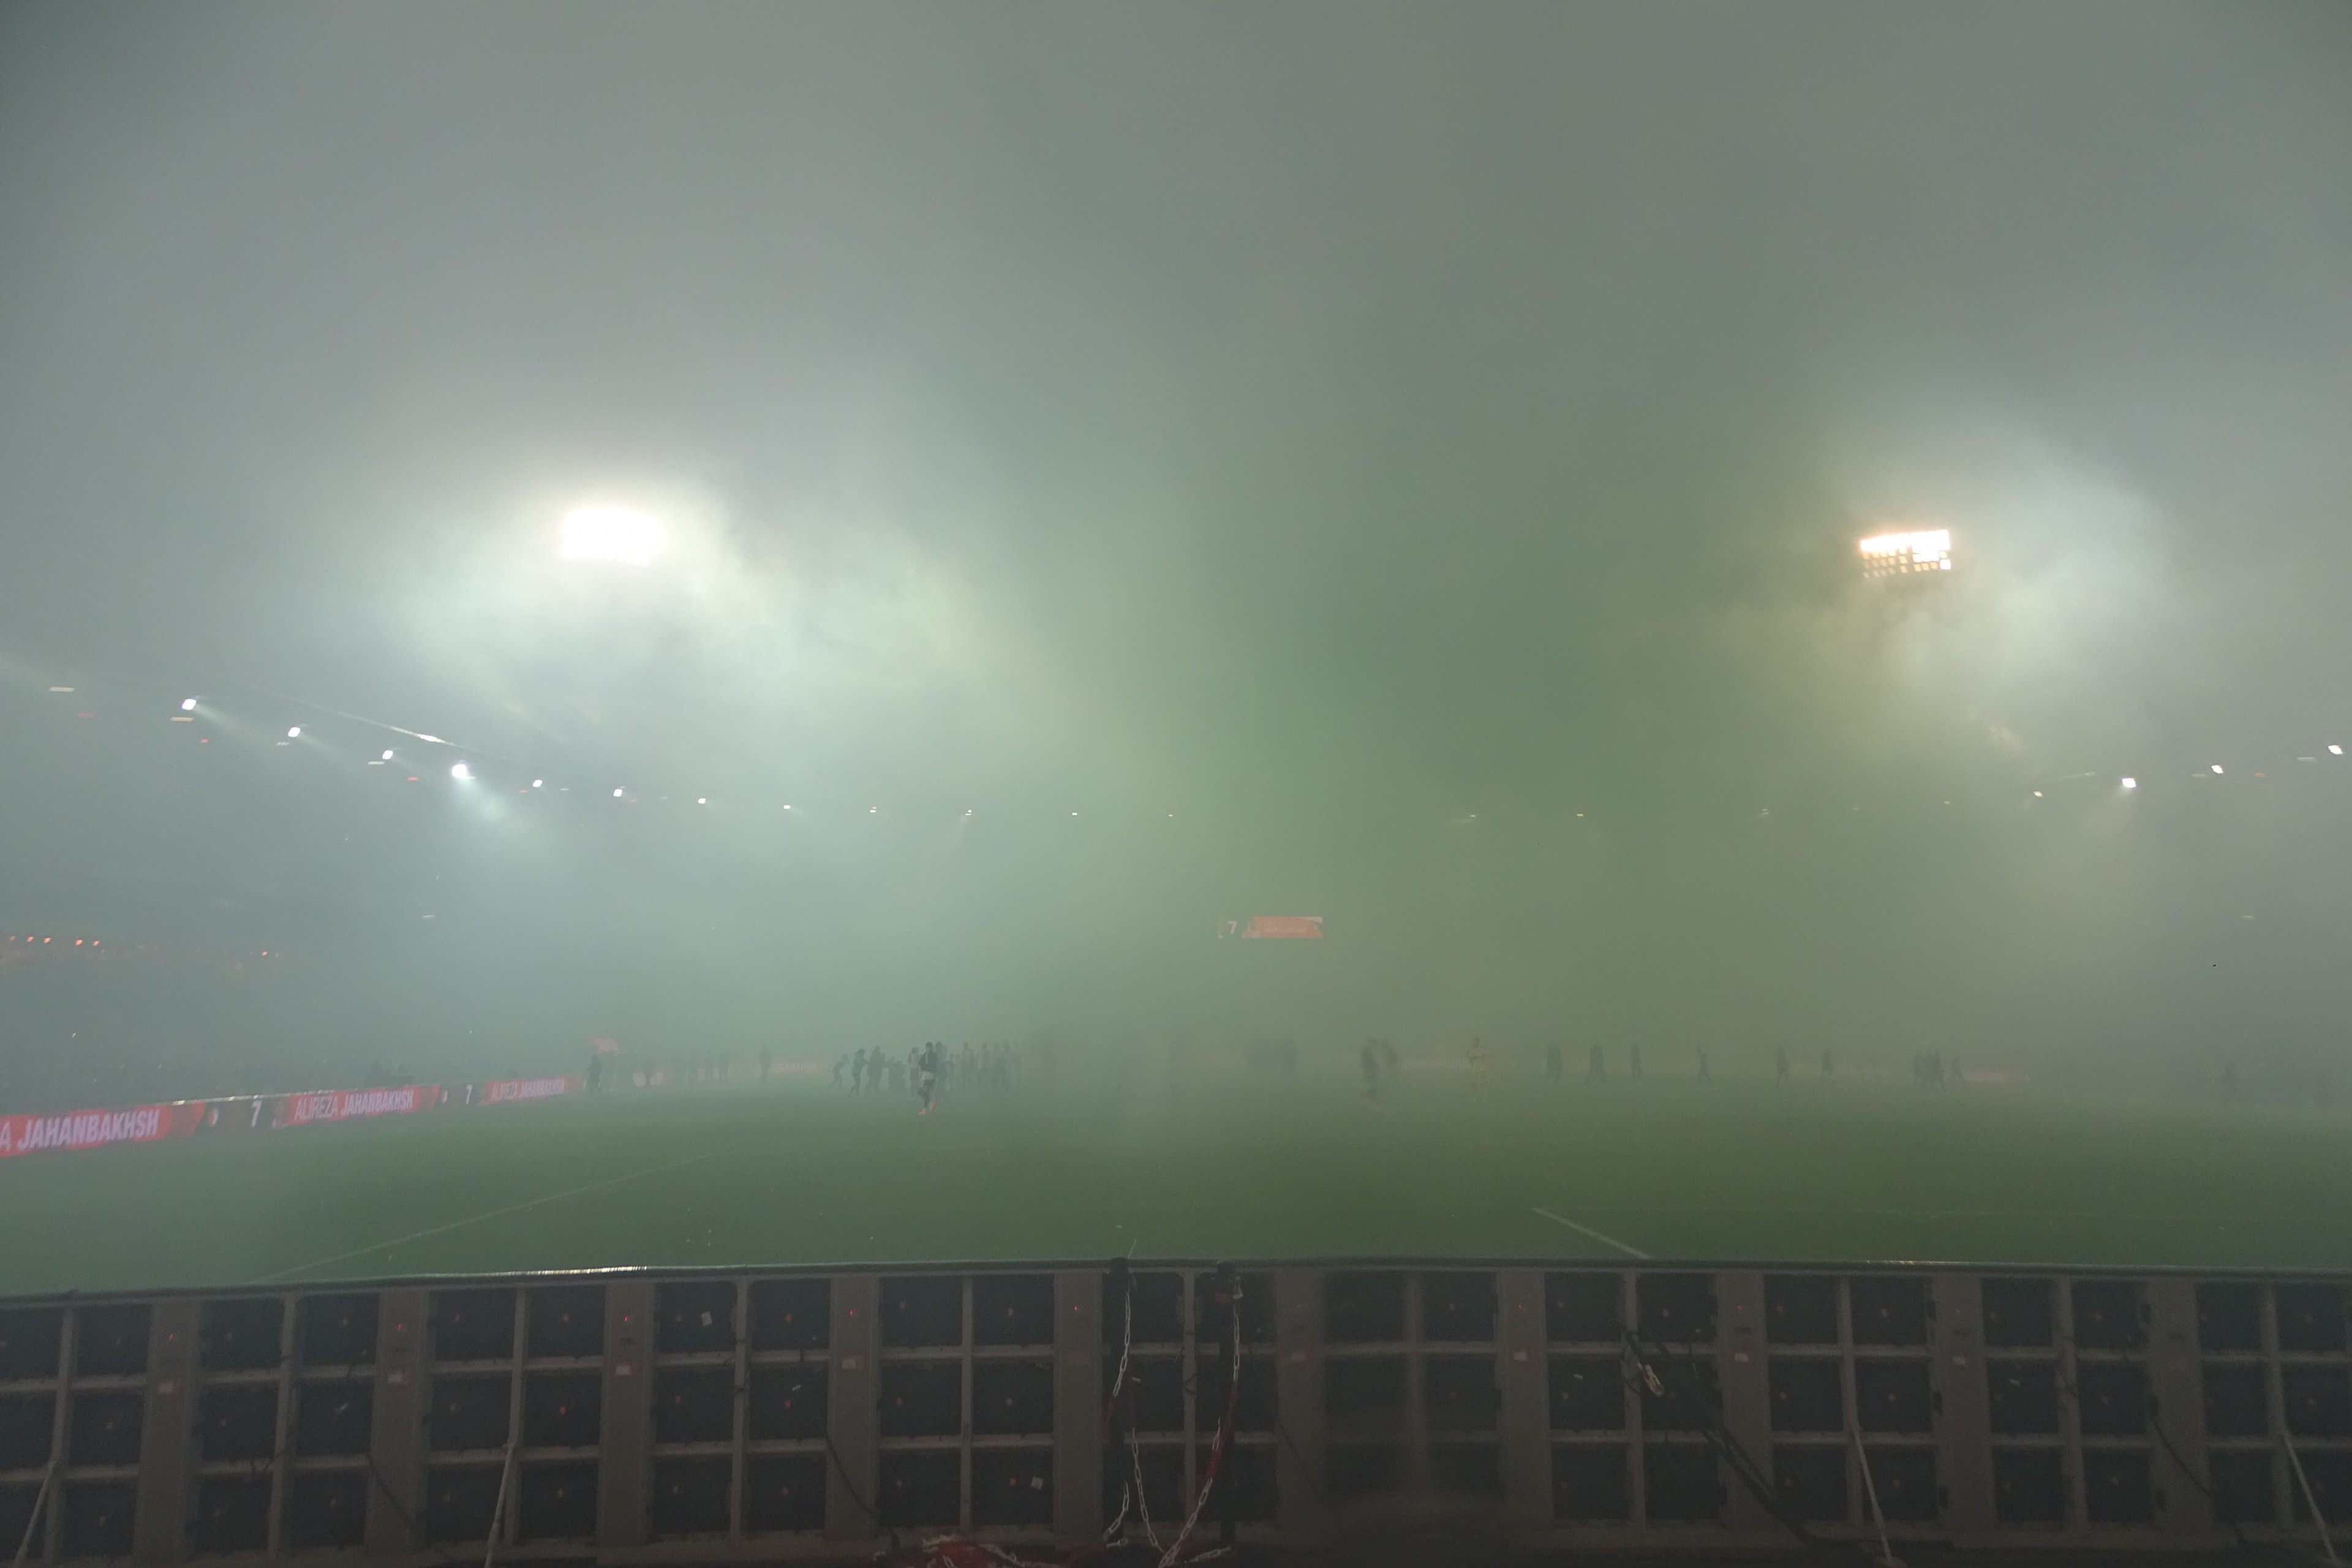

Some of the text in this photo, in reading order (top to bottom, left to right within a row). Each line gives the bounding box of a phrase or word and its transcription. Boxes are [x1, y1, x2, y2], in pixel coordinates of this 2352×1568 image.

[1228, 921, 1238, 935] 7
[249, 1100, 262, 1127] 7
[341, 1090, 415, 1115] JAHANBAKHSH
[17, 1109, 160, 1150] JAHANBAKHSH
